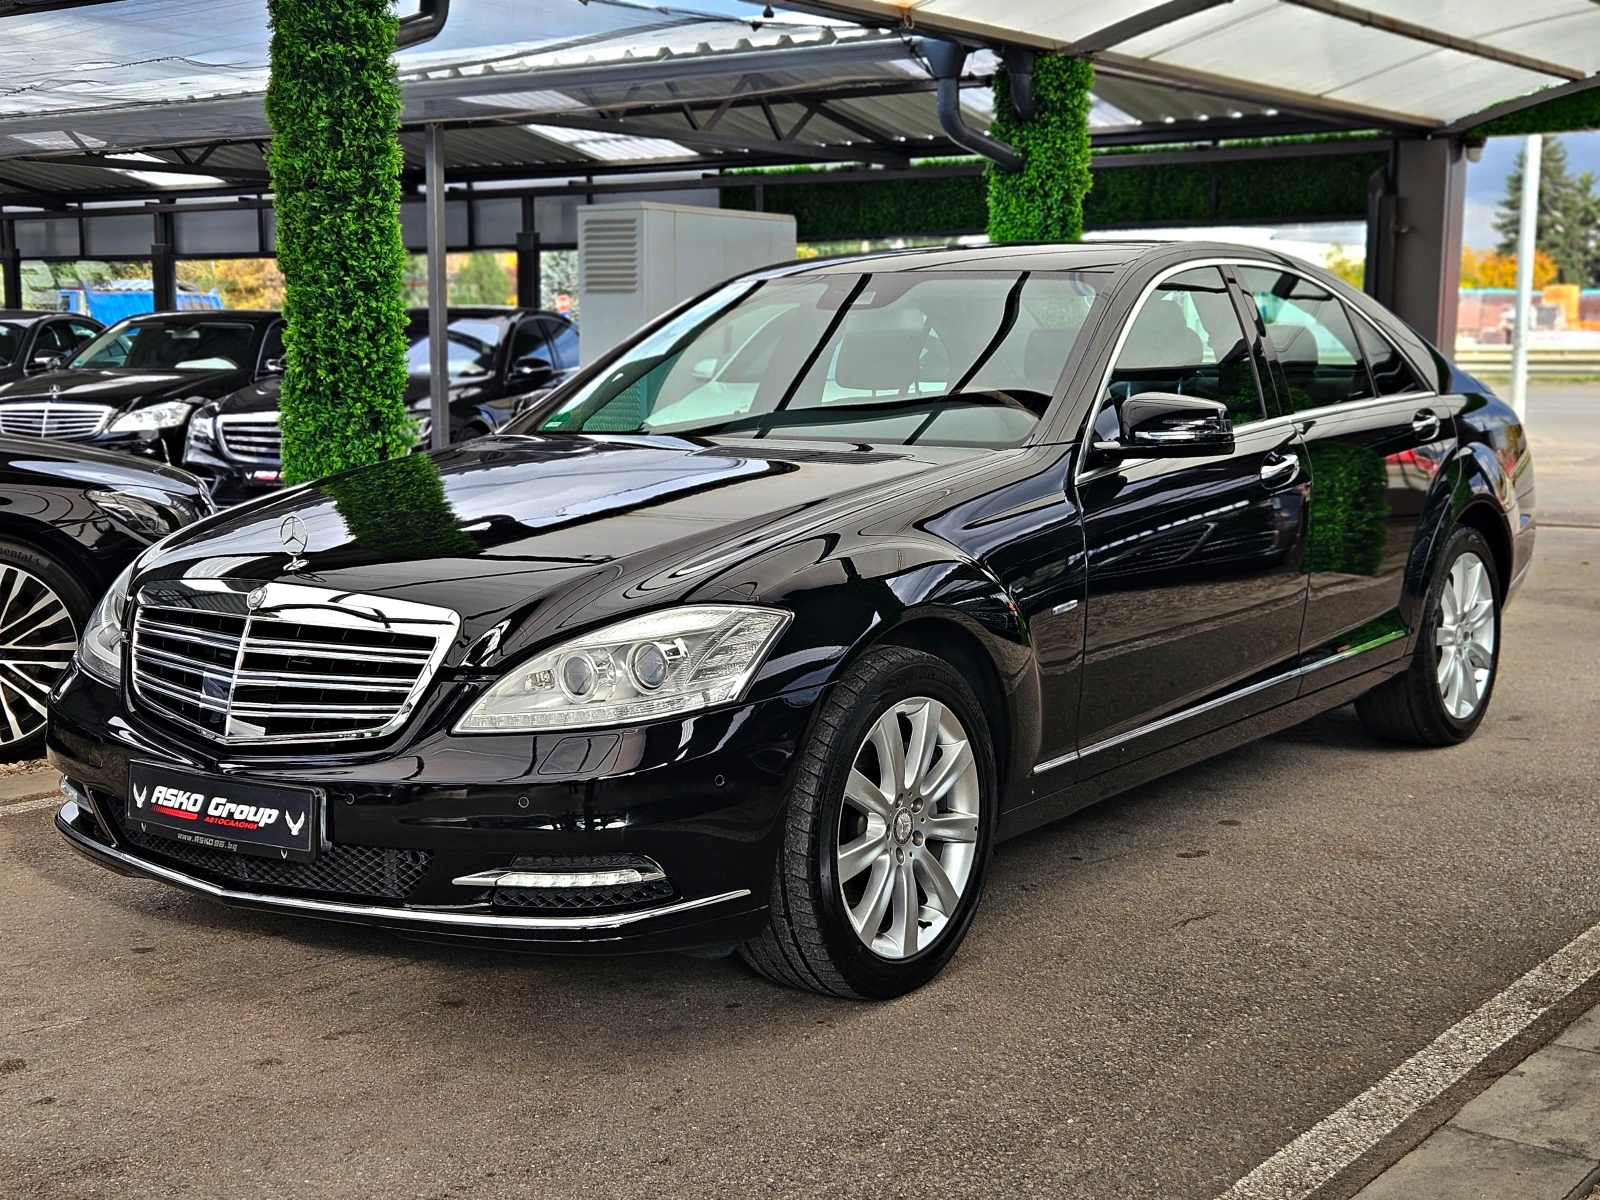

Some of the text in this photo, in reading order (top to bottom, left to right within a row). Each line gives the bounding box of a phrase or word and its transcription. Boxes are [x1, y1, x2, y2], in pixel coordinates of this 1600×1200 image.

[912, 667, 952, 685] DRIVEWAYS
[151, 786, 279, 827] ASKO Group
[204, 816, 258, 830] АВТОСАЛОНИ
